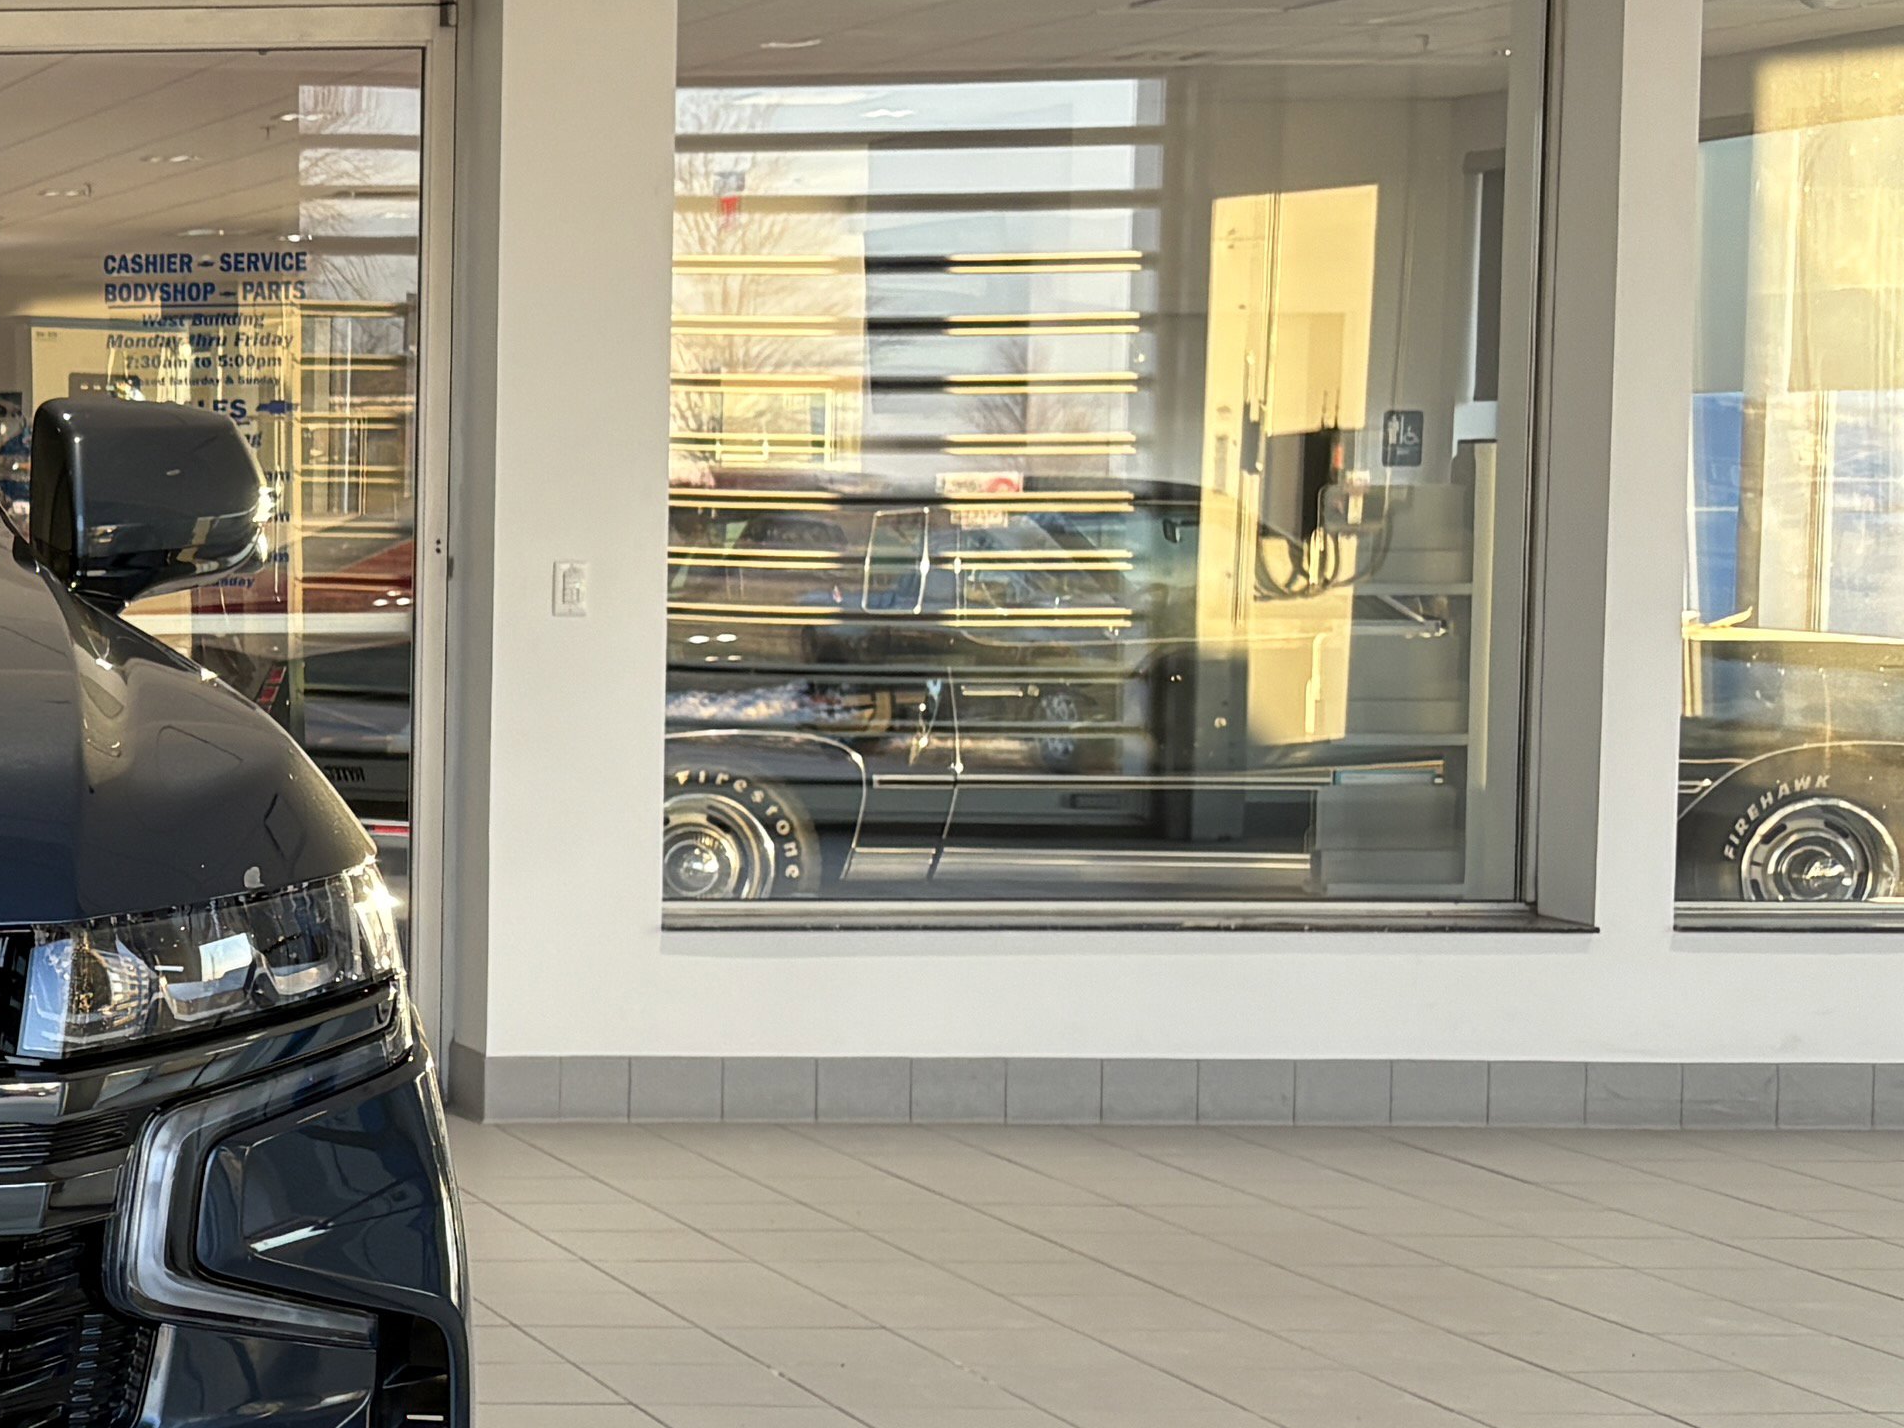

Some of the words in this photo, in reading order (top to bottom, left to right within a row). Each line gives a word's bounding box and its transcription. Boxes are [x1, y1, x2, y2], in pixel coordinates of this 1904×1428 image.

[103, 253, 192, 275] CASHIER
[219, 251, 308, 272] SERVICE
[104, 282, 216, 303] BODYSHOP
[242, 280, 307, 301] PARTS
[106, 334, 183, 352] Monday
[234, 332, 294, 349] Friday
[194, 355, 212, 369] to
[1723, 774, 1831, 860] FIREHAWK
